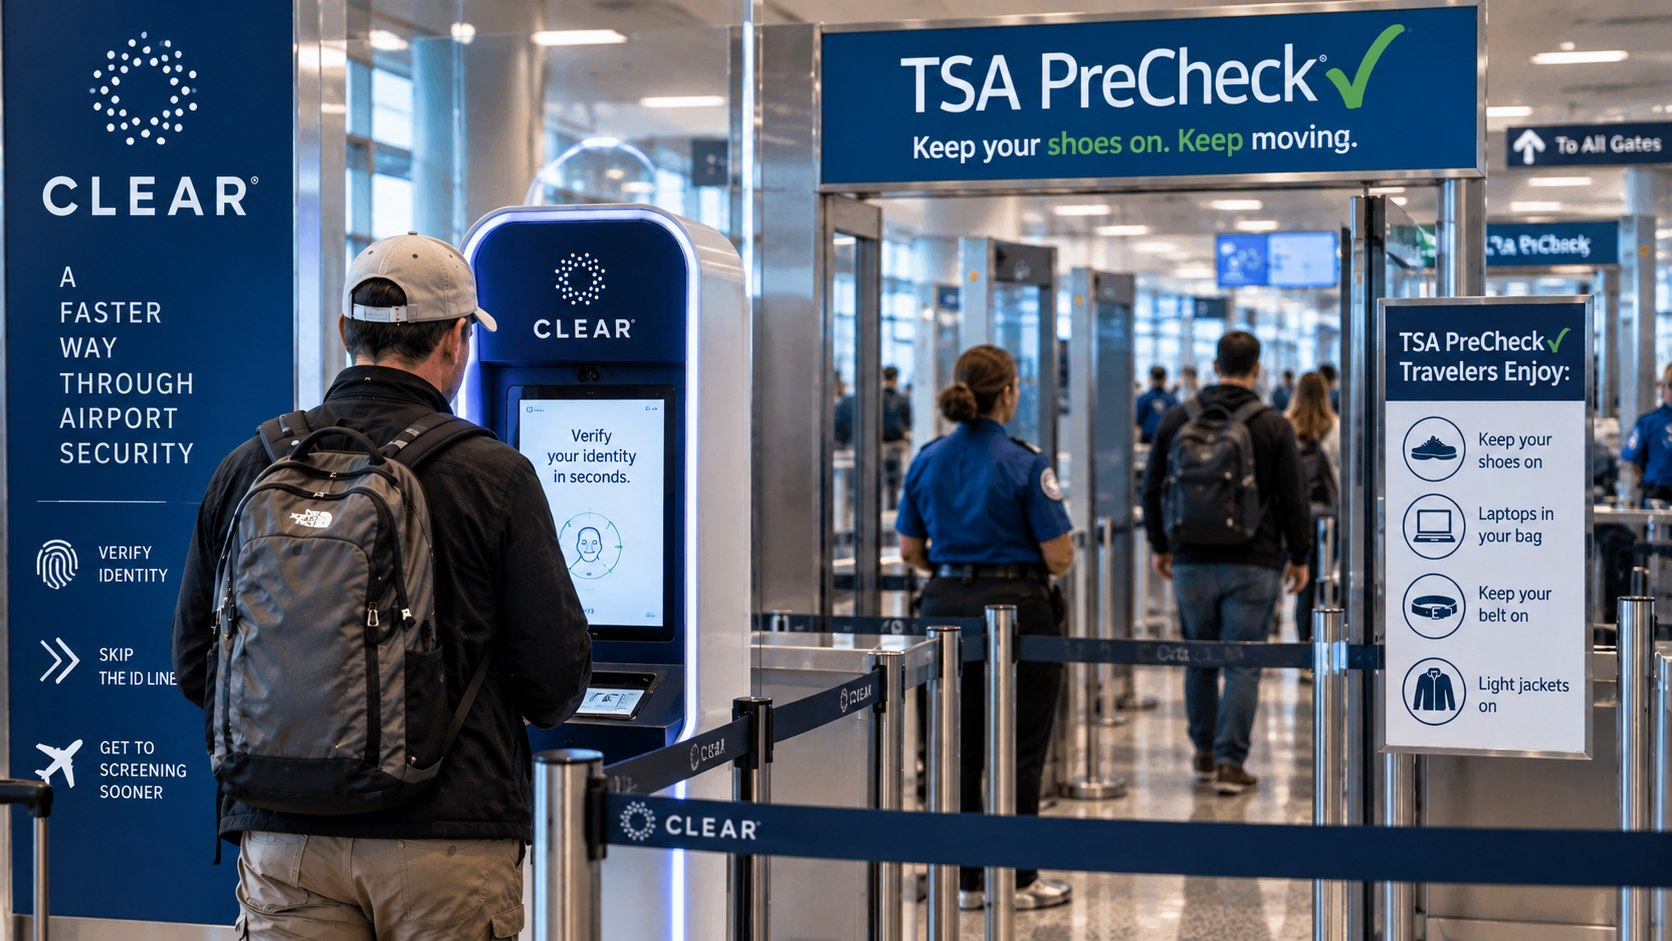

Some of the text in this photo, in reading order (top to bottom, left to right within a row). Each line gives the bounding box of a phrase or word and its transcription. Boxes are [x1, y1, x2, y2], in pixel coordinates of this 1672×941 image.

[901, 55, 1021, 112] TSA
[914, 124, 1357, 163] Keep your shoes on. Keep moving.
[1556, 135, 1661, 153] To All Gates
[60, 266, 76, 287] A
[61, 302, 160, 323] FASTER
[60, 337, 116, 358] WAY
[1399, 330, 1544, 352] TSA PreCheck
[1400, 360, 1569, 386] Travelers Enjoy:
[60, 373, 192, 394] THROUGH
[60, 408, 177, 428] AIRPORT
[572, 429, 612, 445] Verify
[1479, 432, 1552, 449] Keep your
[61, 443, 193, 463] SECURITY
[548, 449, 636, 466] your identity
[1479, 454, 1542, 468] shoes on
[554, 470, 630, 483] in seconds.
[1479, 507, 1553, 523] Laptops in
[1479, 528, 1542, 546] your bag
[99, 546, 151, 559] VERIFY
[100, 569, 168, 582] IDENTITY
[1479, 586, 1551, 603] Keep your
[1480, 608, 1528, 622] belt on
[100, 648, 133, 661] SKIP
[99, 671, 177, 686] THE ID LINE
[1480, 676, 1569, 694] Light jackets
[1479, 702, 1496, 712] on
[101, 741, 154, 754] GET TO
[101, 763, 186, 777] SCREENING
[101, 785, 162, 799] SOONER
